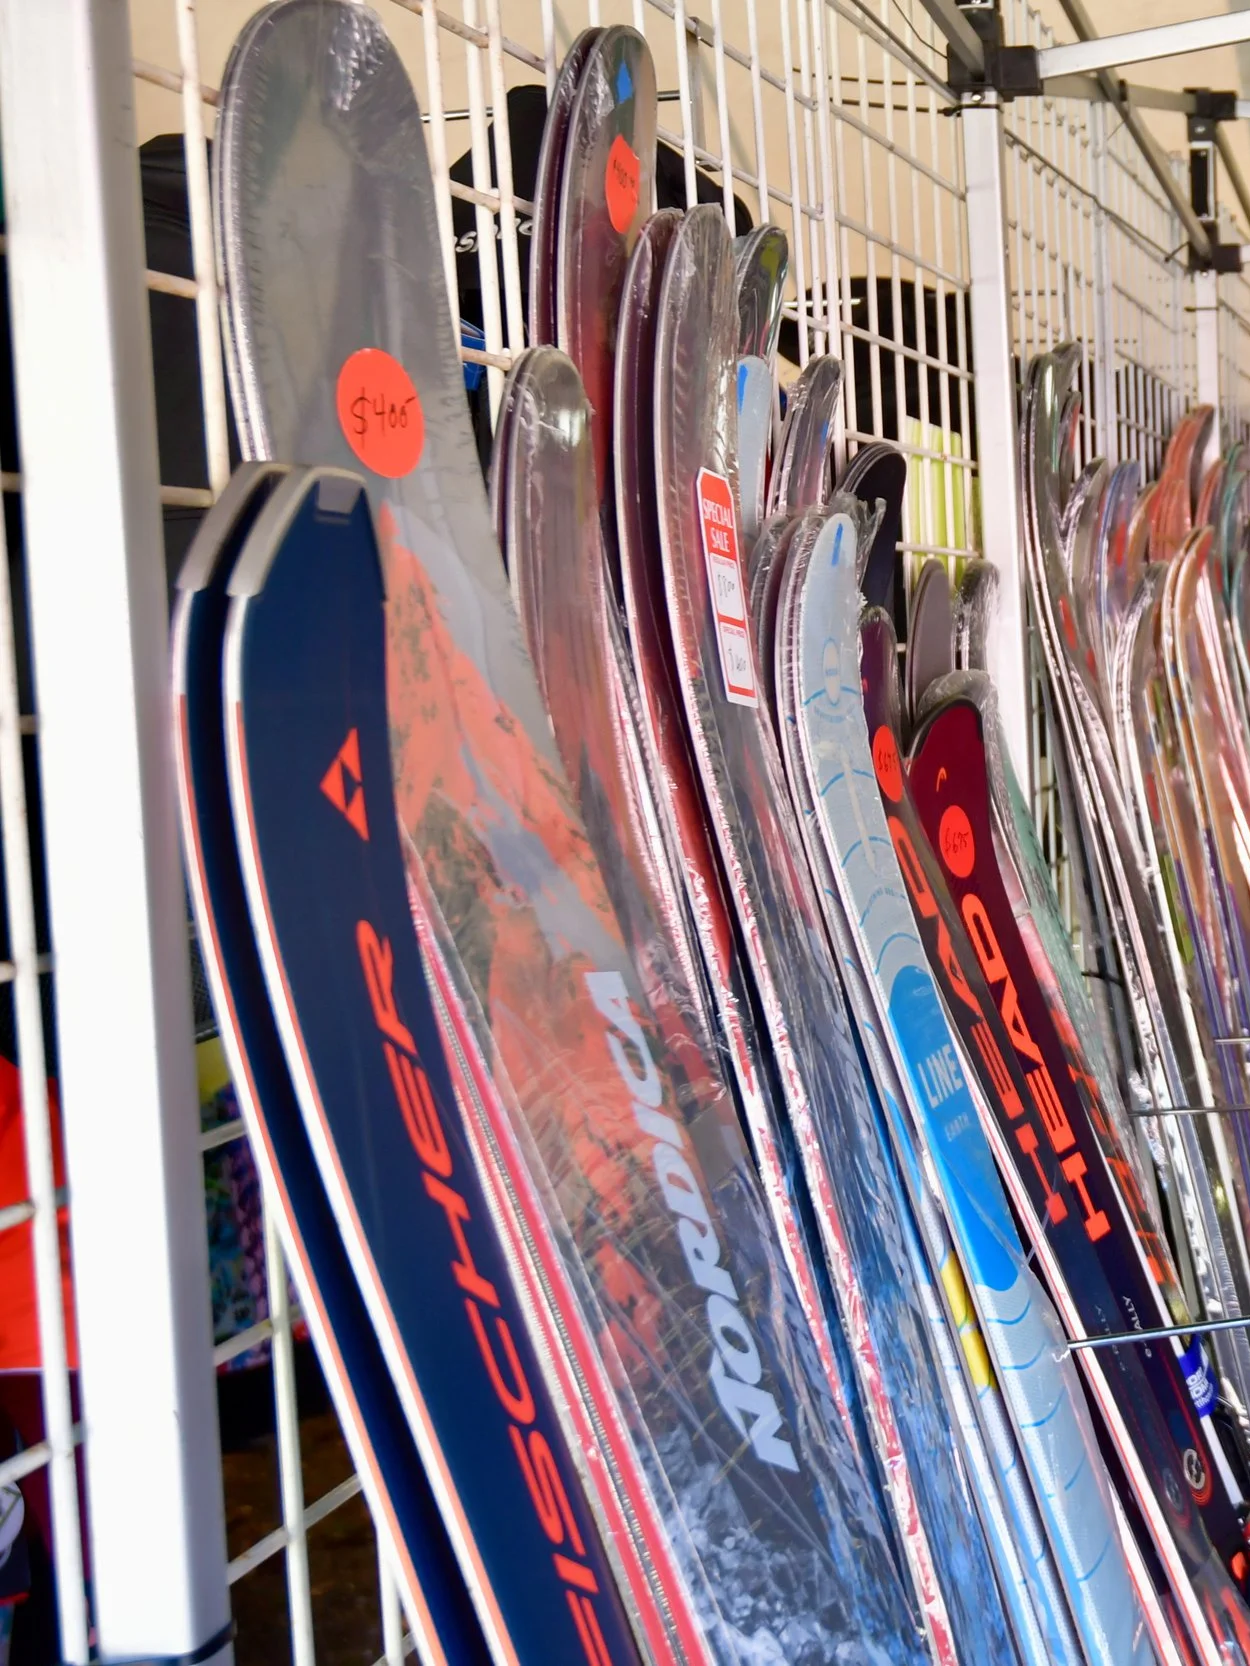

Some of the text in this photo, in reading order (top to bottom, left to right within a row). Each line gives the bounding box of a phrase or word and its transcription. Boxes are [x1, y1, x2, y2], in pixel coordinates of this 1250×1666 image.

[703, 497, 733, 529] SPECIAL
[710, 526, 730, 553] SALE
[887, 815, 1068, 1226] HEAD
[917, 1043, 963, 1109] LINE
[961, 893, 1111, 1242] HEAD
[584, 971, 799, 1472] NORDICA
